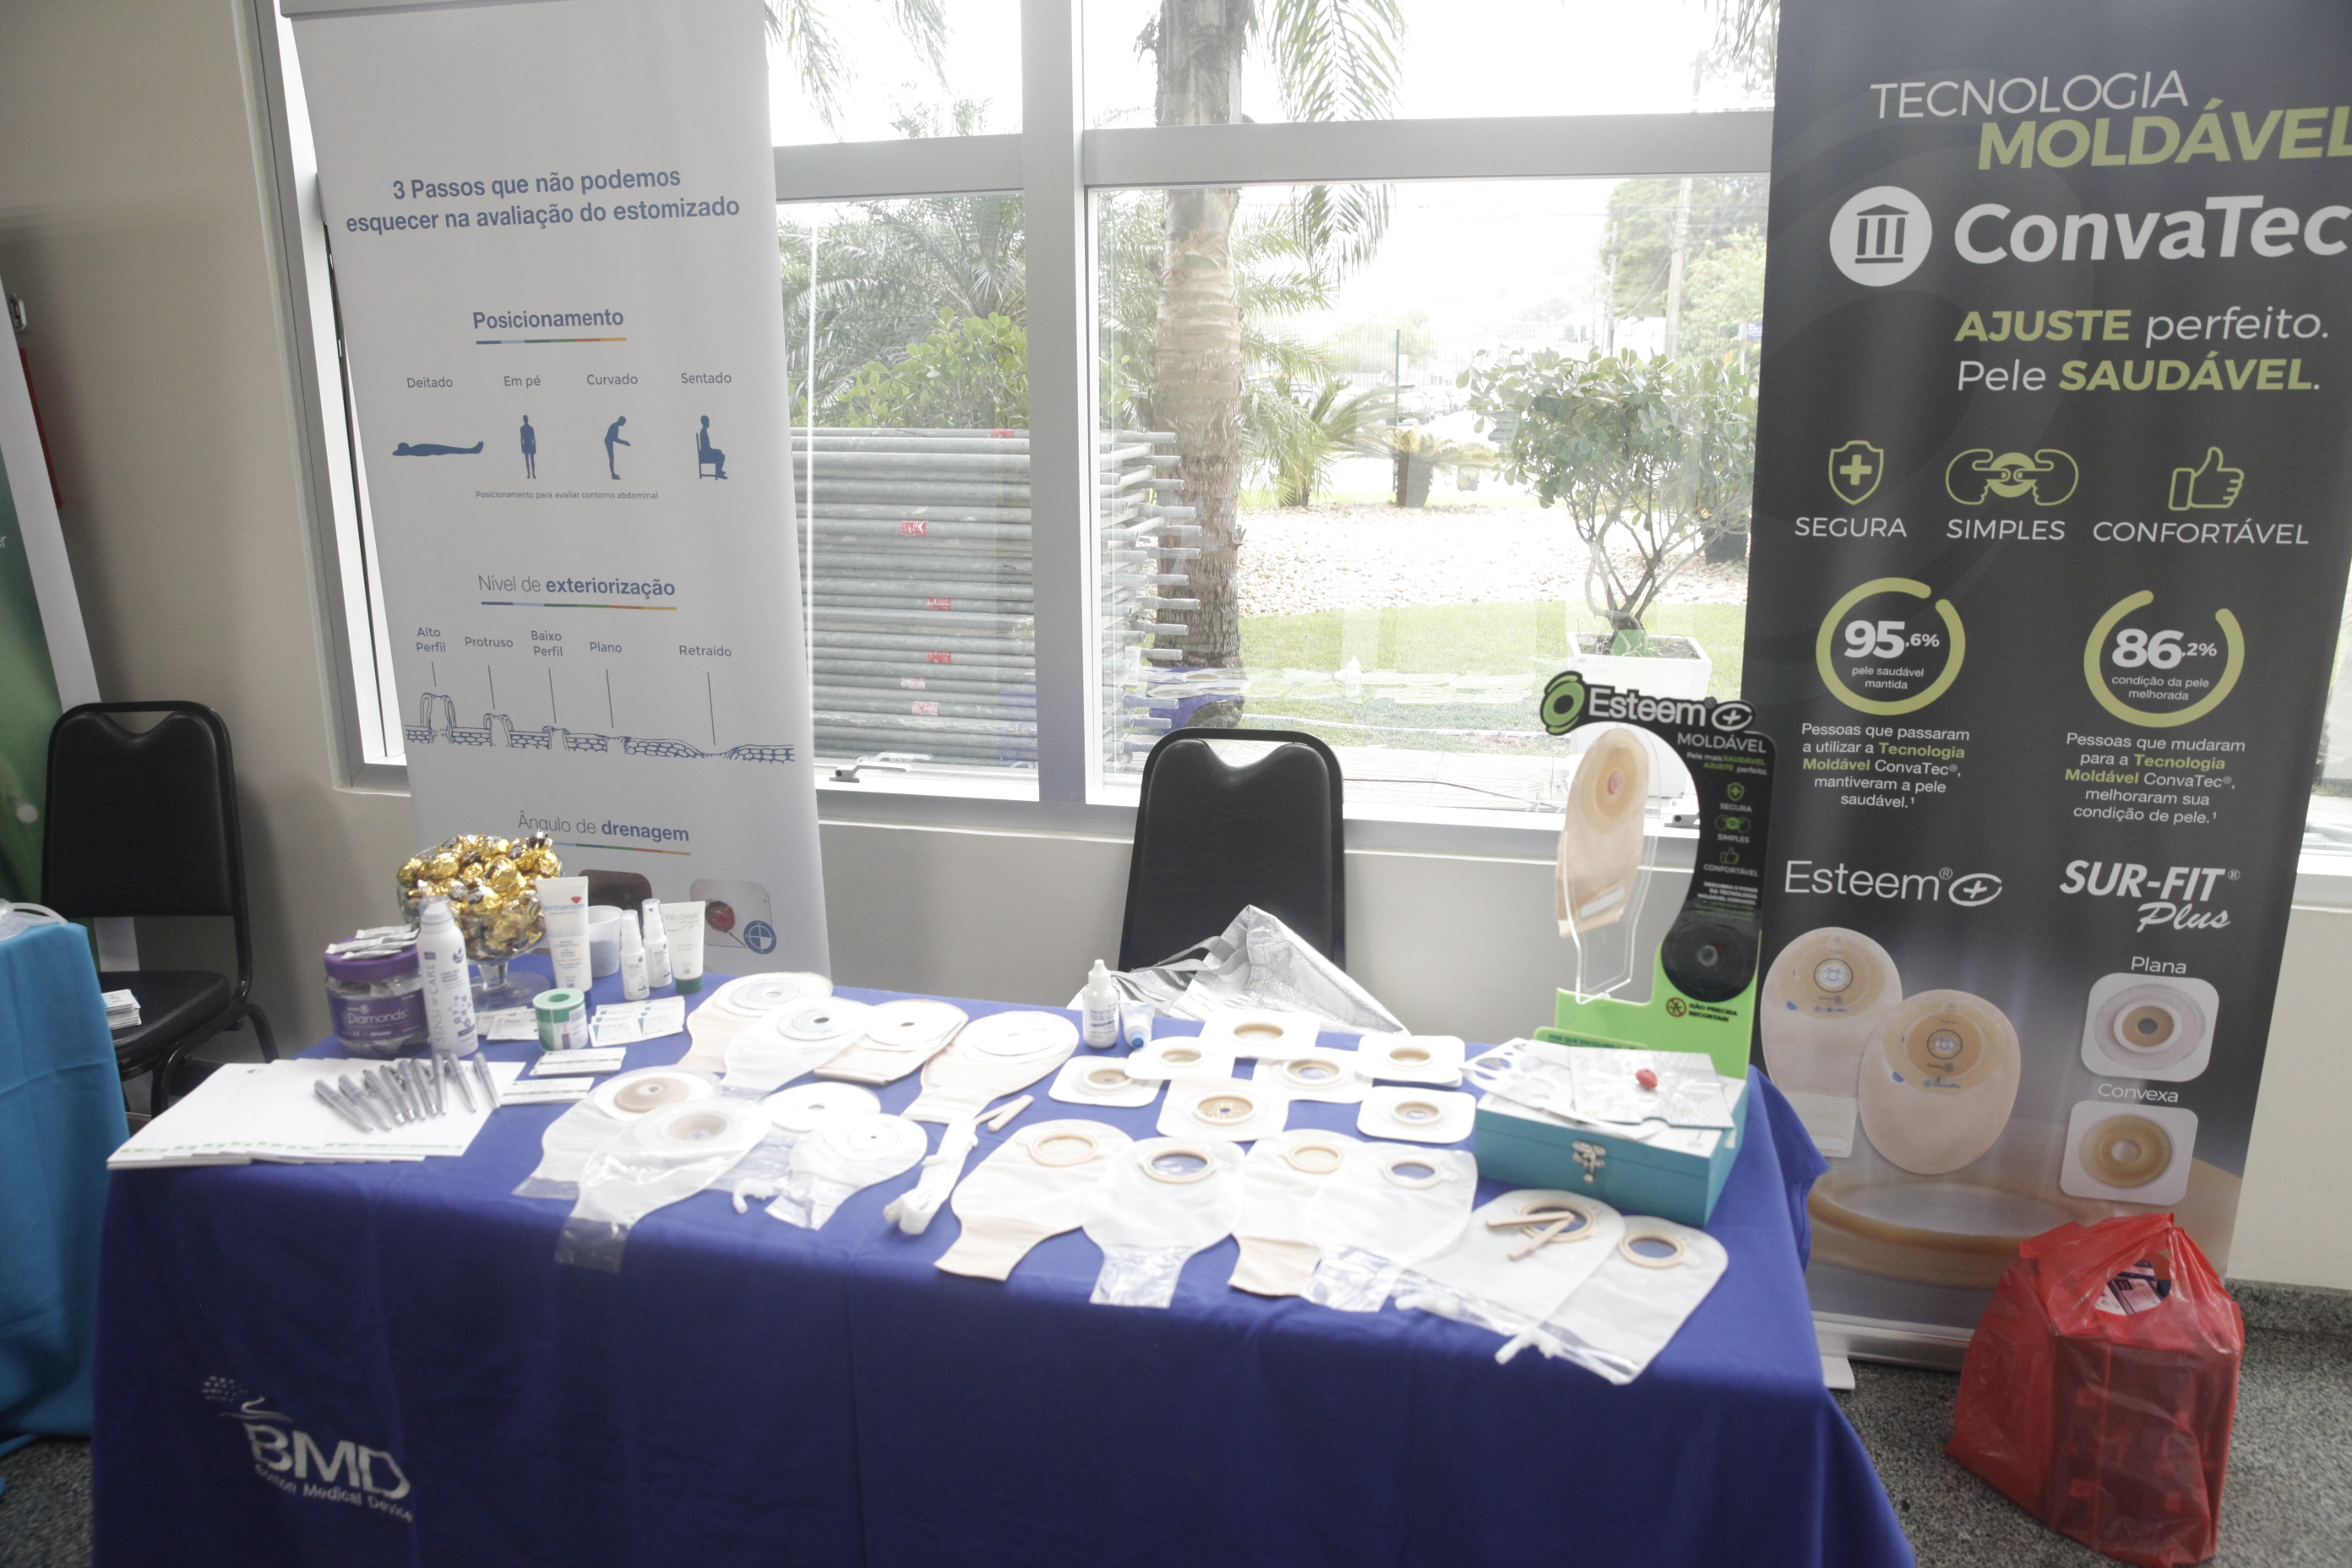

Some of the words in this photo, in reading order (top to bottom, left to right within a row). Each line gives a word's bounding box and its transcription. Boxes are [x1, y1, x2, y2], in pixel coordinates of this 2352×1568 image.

[1870, 70, 2189, 118] TECNOLOGIA
[1979, 97, 2352, 170] MOLDÁVEL
[393, 181, 405, 199] 3
[411, 178, 485, 199] Passos
[492, 178, 529, 199] que
[536, 172, 574, 192] não
[580, 170, 681, 194] podemos
[346, 215, 438, 235] esquecer
[445, 211, 470, 227] na
[476, 201, 573, 229] avaliação
[580, 202, 607, 222] do
[613, 195, 739, 220] estomizado
[1955, 195, 2352, 264] ConvaTec
[473, 309, 623, 329] Posicionamento
[1954, 309, 2132, 341] AJUSTE
[2145, 306, 2329, 348] perfeito.
[586, 373, 638, 386] Curvado
[681, 373, 732, 384] Sentado
[1957, 359, 2045, 390] Pele
[2059, 350, 2320, 390] SAUDÁVEL.
[407, 377, 453, 389] Deitado
[504, 376, 522, 387] Em
[525, 375, 541, 389] pé
[1794, 517, 1907, 538] SEGURA
[1946, 519, 2066, 541] SIMPLES
[2093, 519, 2309, 544] CONFORTÁVEL
[479, 574, 516, 591] Nível
[521, 577, 541, 592] de
[546, 578, 675, 599] exteriorização
[417, 627, 440, 638] Alto
[465, 636, 513, 648] Protruso
[531, 630, 562, 641] Baixo
[416, 642, 446, 652] Perfil
[534, 645, 562, 656] Perfil
[590, 641, 622, 653] Plano
[679, 644, 732, 657] Retraído
[1852, 667, 1871, 679] pele
[1874, 666, 1925, 678] saudável
[1865, 678, 1908, 689] mantida
[2112, 675, 2164, 689] condição
[2167, 677, 2182, 688] da
[2186, 677, 2209, 690] pele
[2128, 688, 2189, 700] melhorada
[1677, 732, 1767, 753] MOLDÁVEL
[1801, 723, 1861, 738] Pessoas
[1865, 727, 1893, 741] que
[1897, 727, 1970, 743] passaram
[2066, 732, 2132, 749] Pessoas
[2136, 738, 2166, 753] que
[2171, 737, 2246, 753] mudaram
[1803, 743, 1811, 753] a
[1816, 740, 1861, 754] utilizar
[1865, 744, 1874, 754] a
[1879, 743, 1965, 760] Tecnologia
[1803, 758, 1870, 772] Moldável
[2080, 753, 2115, 768] para
[2120, 755, 2129, 765] a
[2134, 753, 2225, 772] Tecnologia
[2065, 767, 2139, 785] Moldável
[1815, 776, 1897, 792] mantiveram
[1902, 782, 1910, 792] a
[1914, 781, 1946, 797] pele
[2085, 787, 2177, 804] melhoraram
[2181, 794, 2210, 806] sua
[1720, 803, 1751, 812] SEGURA
[2073, 805, 2145, 823] condição
[2149, 808, 2169, 822] de
[518, 811, 571, 834] Ângulo
[576, 819, 596, 834] de
[602, 820, 689, 843] drenagem
[1718, 833, 1750, 843] SIMPLES
[1703, 863, 1757, 877] CONFORTÁVEL
[2137, 901, 2230, 933] Plus
[2131, 956, 2187, 975] Plana
[348, 1010, 407, 1024] Diamonds
[2098, 1082, 2179, 1103] Convexa
[242, 1422, 411, 1500] BMD
[303, 1482, 362, 1506] Medical
